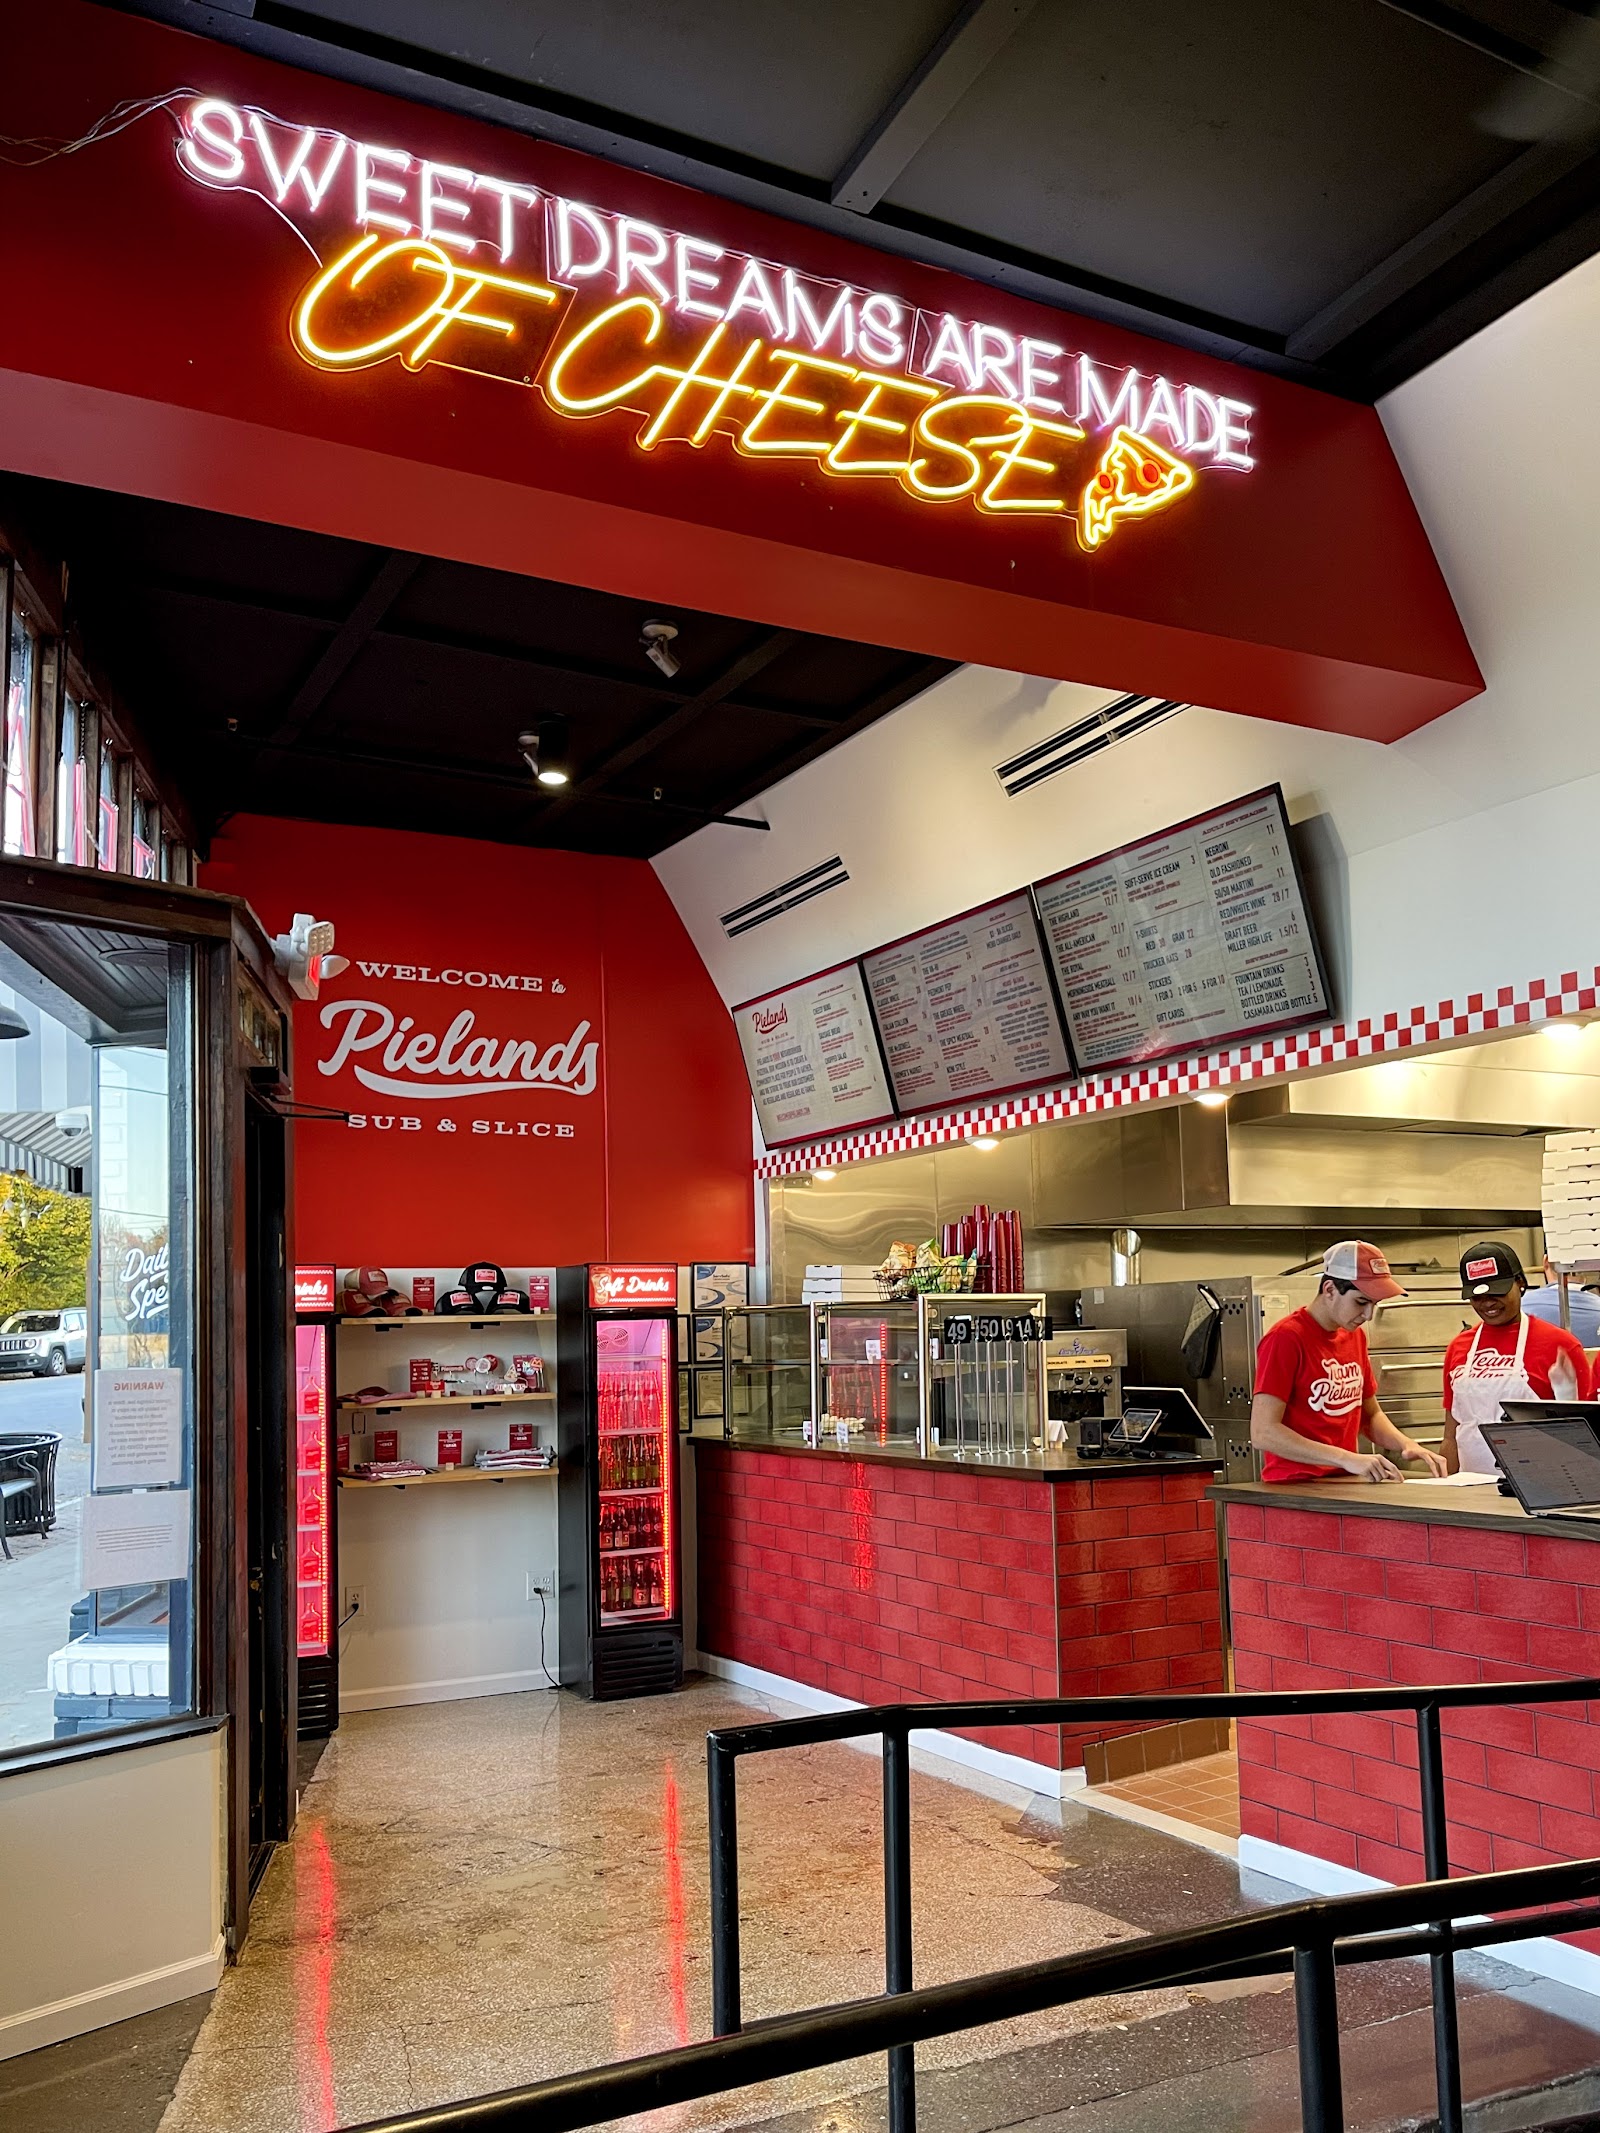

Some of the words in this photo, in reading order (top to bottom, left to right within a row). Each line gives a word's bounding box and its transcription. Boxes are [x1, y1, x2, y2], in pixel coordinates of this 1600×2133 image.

[183, 99, 536, 262] SWEET
[557, 197, 904, 365] DREAMS
[924, 314, 1063, 412] ARE
[1078, 353, 1256, 467] MADE
[298, 233, 557, 368] OF
[550, 297, 1086, 508] CHEESE
[1204, 840, 1229, 858] NEGRONI
[1266, 823, 1274, 835] 11
[1123, 870, 1153, 889] SOFT-SERVE
[1152, 867, 1162, 878] ICE
[1161, 860, 1180, 875] CREAM
[1190, 854, 1195, 864] 3
[1208, 866, 1220, 878] OLD
[1220, 854, 1252, 874] FASHIONED
[1271, 844, 1279, 856] 11
[1229, 877, 1254, 894] MARTINI
[1276, 866, 1284, 878] 11
[1048, 916, 1057, 926] THE
[1057, 908, 1079, 923] HIGHLAND
[1218, 901, 1250, 920] RED/WHITE
[1249, 895, 1266, 910] WINE
[1055, 943, 1064, 953] THE
[1063, 932, 1095, 950] ALL-AMERICAN
[1135, 924, 1158, 939] T-SHIRTS
[1144, 940, 1156, 951] RED
[1171, 930, 1185, 943] GRAY
[1223, 927, 1242, 941] DRAFT
[1242, 922, 1257, 935] BEER
[1226, 938, 1247, 953] MILLER
[1246, 934, 1260, 947] HIGH
[1259, 930, 1273, 943] LIFE
[1060, 966, 1069, 976] THE
[1142, 956, 1165, 970] TRUCKER
[1165, 952, 1178, 964] HATS
[1234, 969, 1262, 985] FOUNTAIN
[1262, 963, 1285, 977] DRINKS
[1303, 956, 1309, 966] 3
[356, 961, 542, 992] WELCOME
[552, 978, 566, 994] to
[1147, 975, 1172, 990] STICKERS
[1158, 990, 1169, 1001] FOR
[1205, 976, 1217, 988] FOR
[1237, 985, 1248, 997] TEA
[1252, 976, 1283, 993] LEMONADE
[1307, 968, 1312, 978] 3
[1240, 993, 1264, 1008] BOTTLED
[1264, 988, 1286, 1002] DRINKS
[1309, 980, 1315, 990] 3
[1242, 1003, 1274, 1019] CASAMARA
[1273, 999, 1290, 1012] CLUB
[1289, 994, 1312, 1008] BOTTLE
[1312, 992, 1318, 1003] 5
[750, 1001, 789, 1037] Pielands
[1071, 1011, 1081, 1021] ANY
[1080, 1009, 1090, 1018] WAY
[1089, 1006, 1098, 1016] YOU
[1098, 1003, 1111, 1014] WANT
[1155, 1012, 1167, 1023] GIFT
[1167, 1007, 1185, 1020] CARDS
[317, 1000, 599, 1099] Pielands
[348, 1114, 422, 1130] SUB
[437, 1119, 456, 1132] &
[472, 1120, 574, 1137] SLICE
[120, 1243, 169, 1283] Dail
[295, 1280, 328, 1296] rinks
[597, 1276, 625, 1297] Soft
[626, 1276, 669, 1293] Drinks
[947, 1322, 967, 1341] 49
[980, 1319, 999, 1337] 50
[1016, 1318, 1033, 1338] 14
[1472, 1350, 1516, 1368] Team
[1311, 1381, 1361, 1409] Pieland
